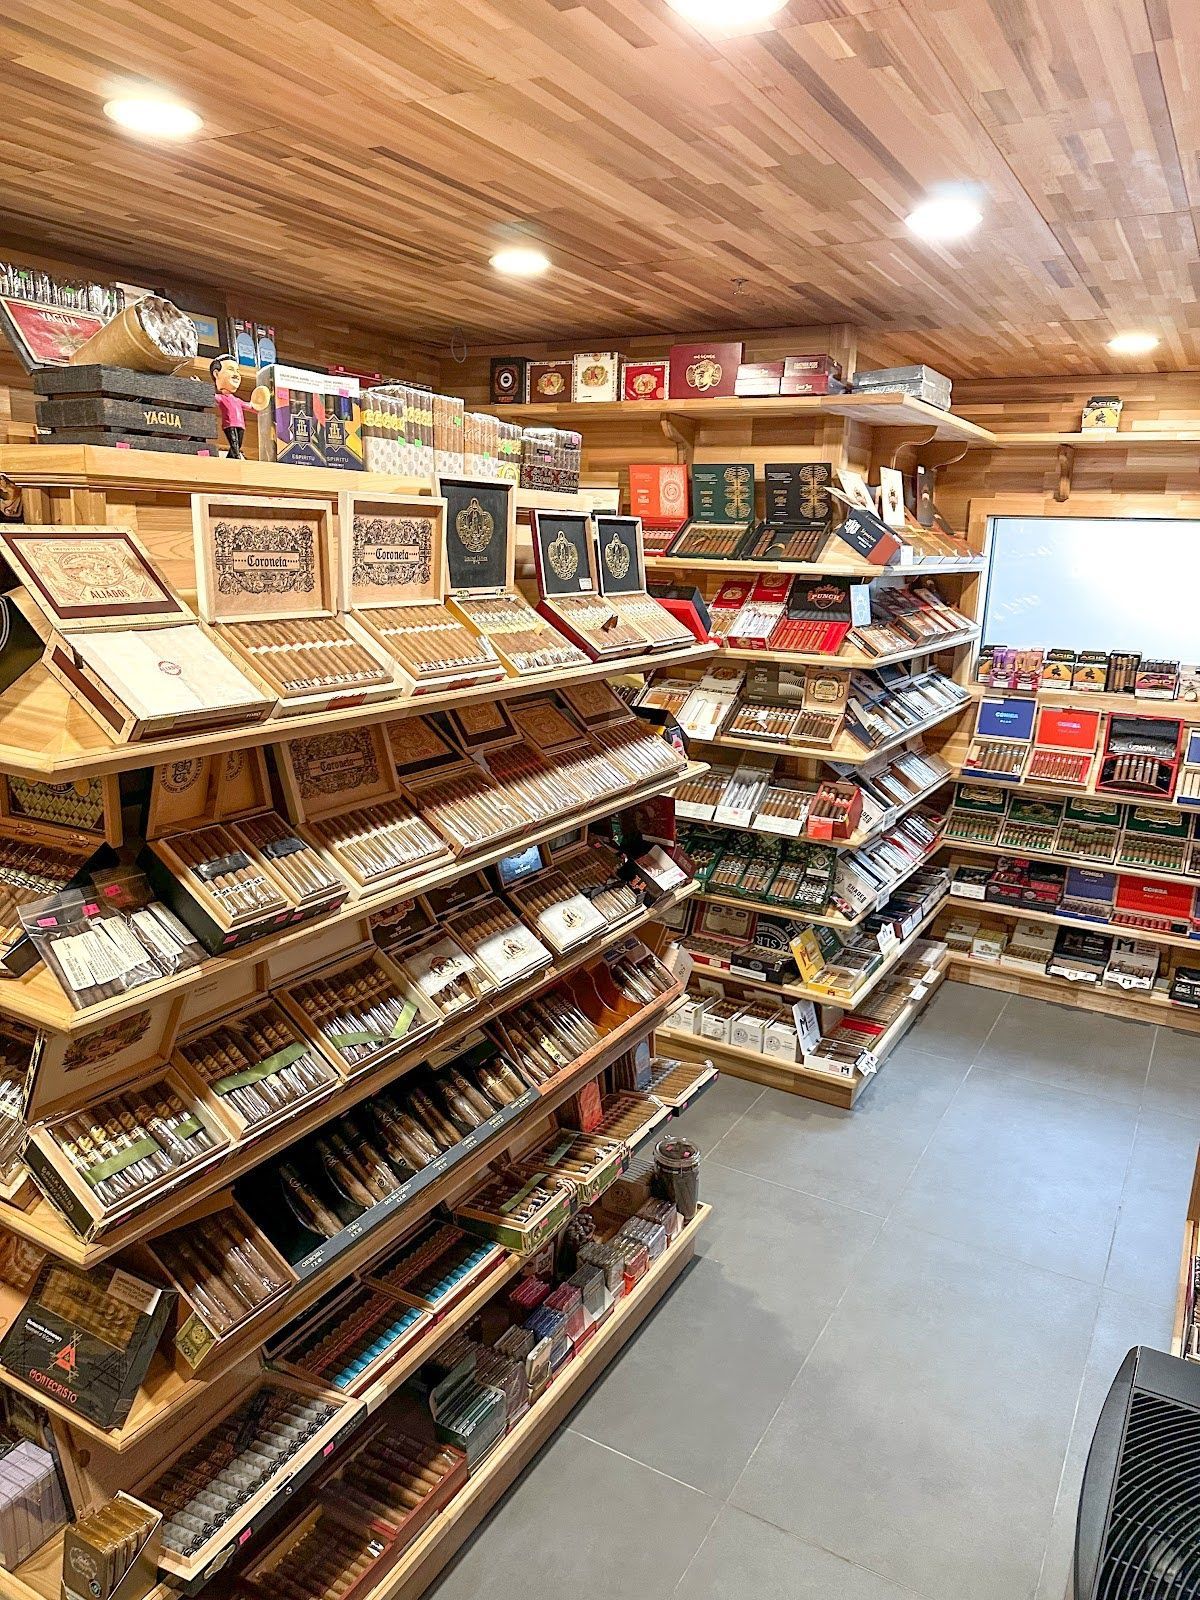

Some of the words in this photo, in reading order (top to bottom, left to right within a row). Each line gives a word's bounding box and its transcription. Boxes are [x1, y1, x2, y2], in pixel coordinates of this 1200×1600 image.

[143, 410, 182, 429] YAGUA
[291, 453, 316, 462] ESPIRITU
[90, 588, 131, 599] ALIADOS
[811, 592, 841, 601] PUNCH
[1049, 652, 1075, 660] ACID
[1080, 869, 1105, 878] COHIBA
[1142, 886, 1168, 895] COHIBA
[755, 935, 777, 949] SLR
[840, 1066, 850, 1074] M
[29, 1368, 77, 1404] MONTECRISTO
